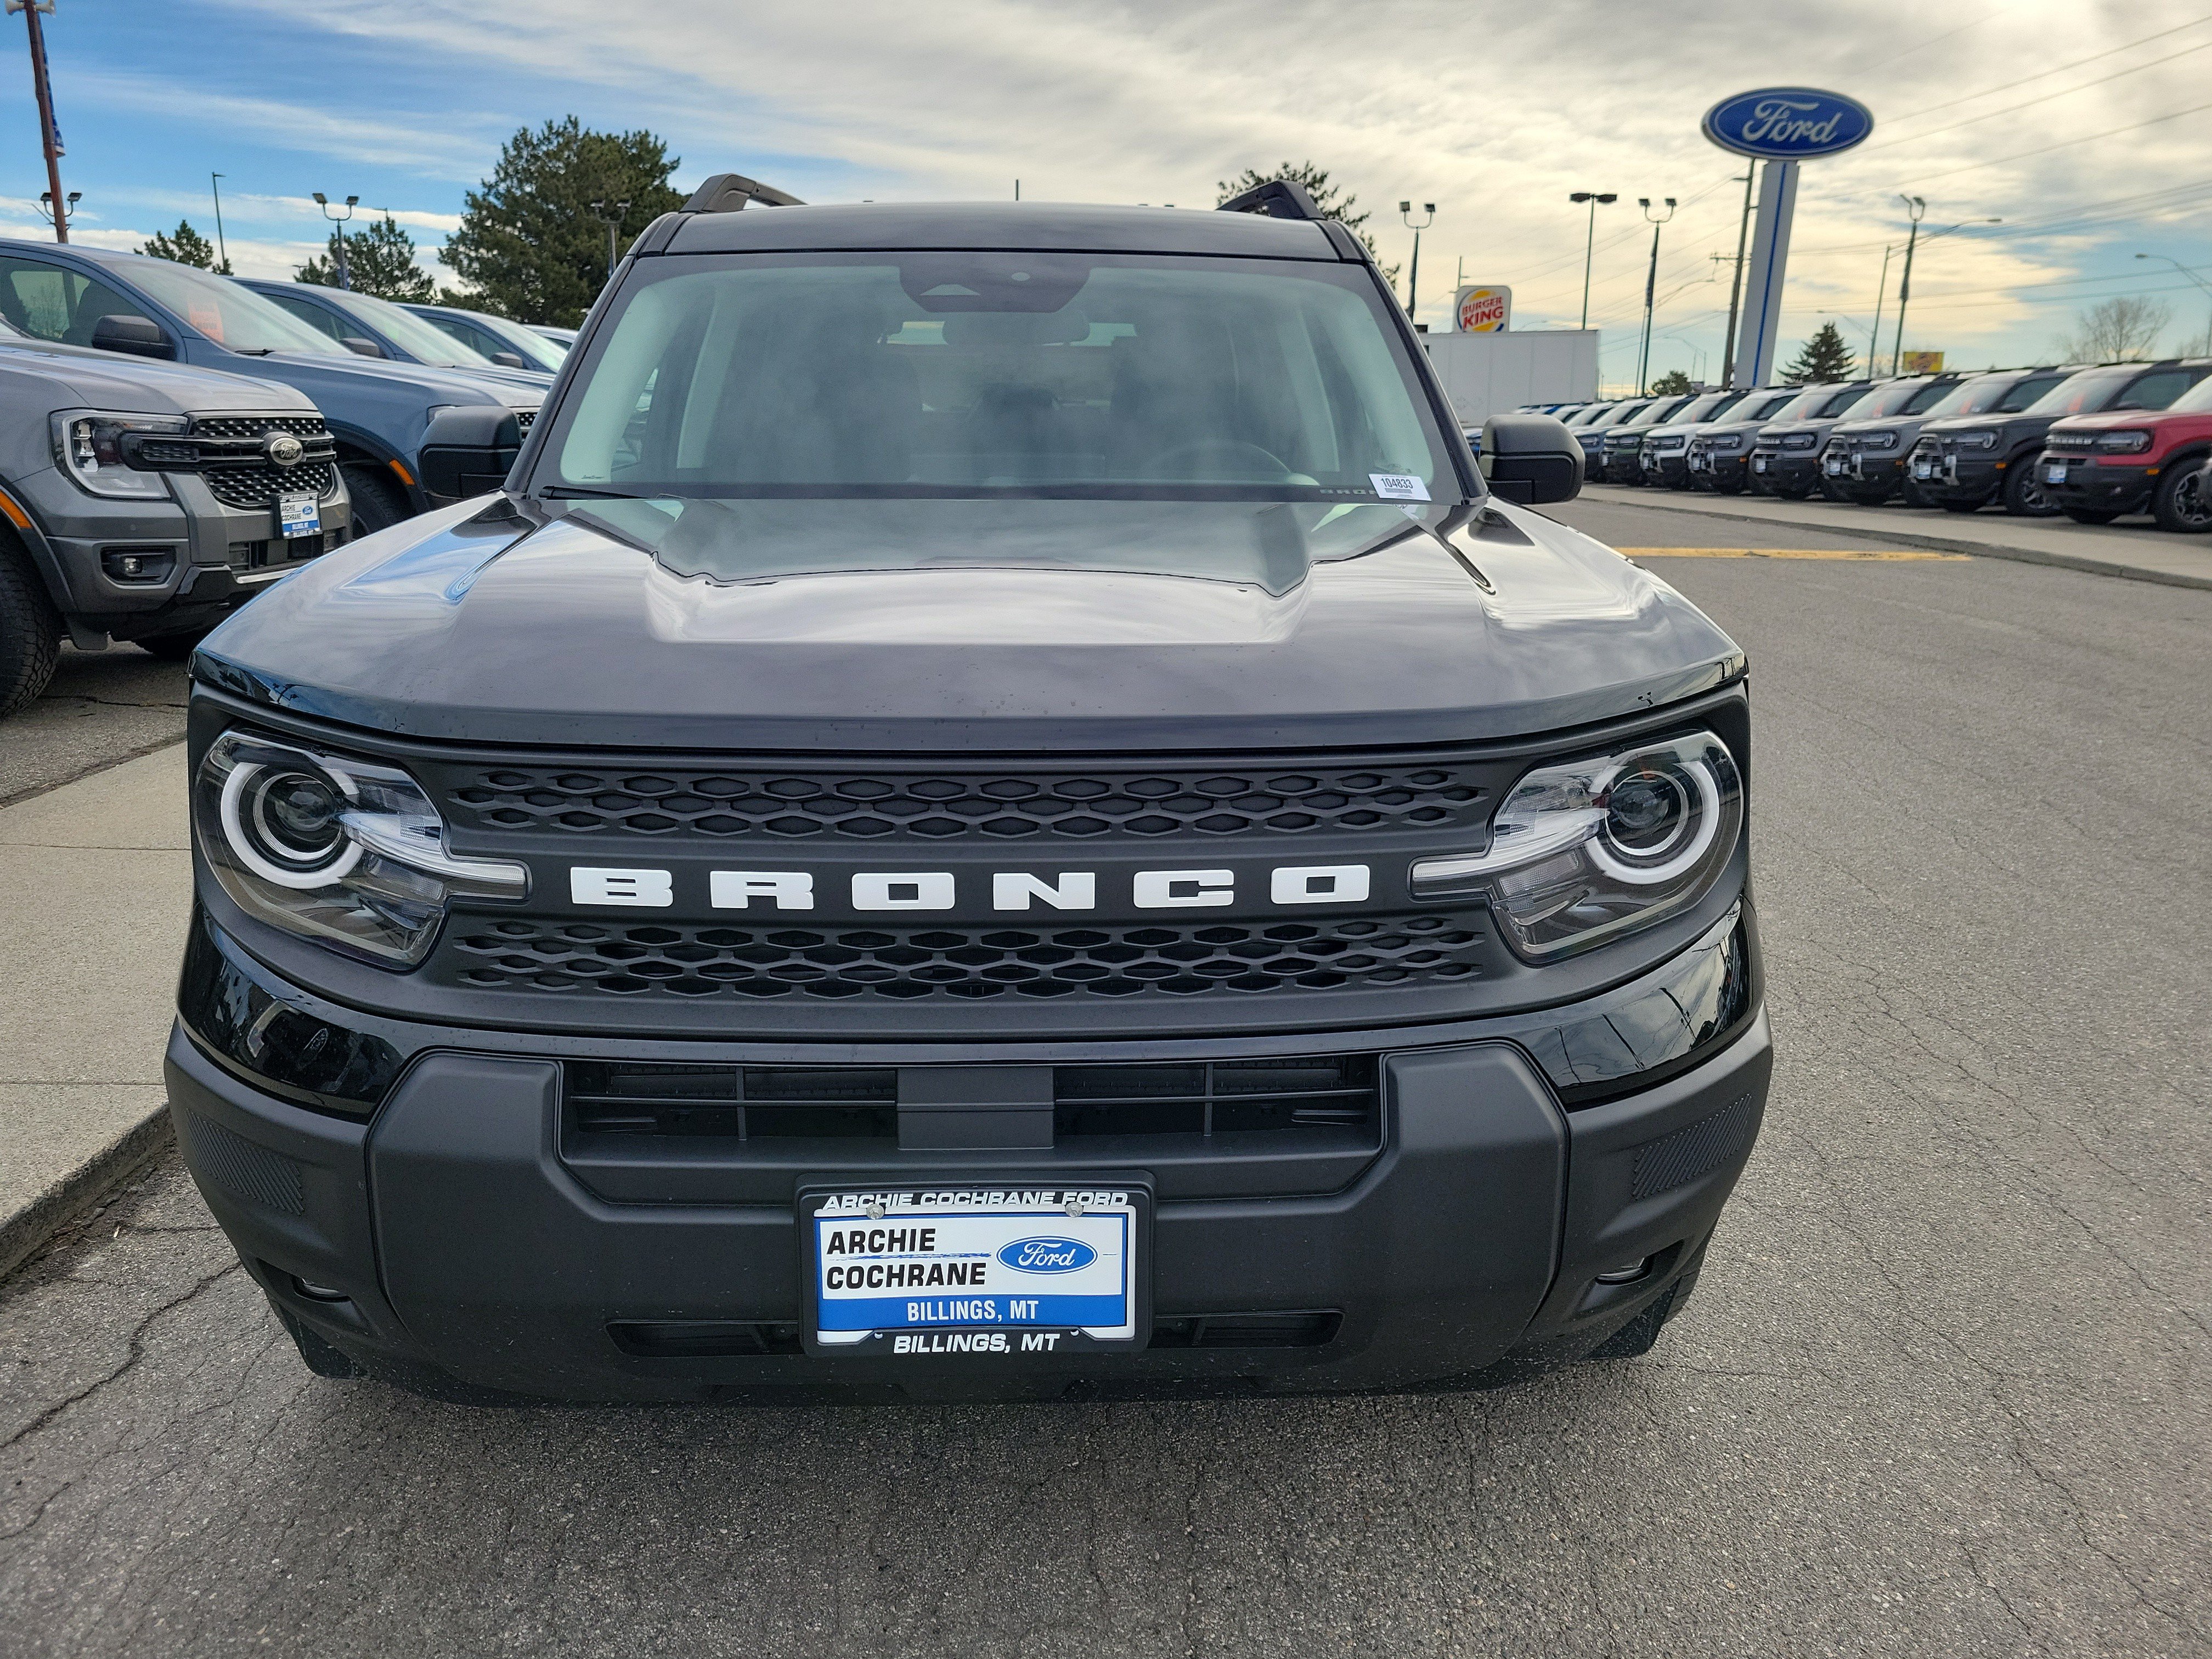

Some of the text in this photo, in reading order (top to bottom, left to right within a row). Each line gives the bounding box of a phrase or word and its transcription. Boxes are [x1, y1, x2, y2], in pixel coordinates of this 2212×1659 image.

[1742, 99, 1843, 143] Ford
[1463, 306, 1503, 330] KING
[1381, 478, 1413, 489] 104833
[571, 865, 1370, 910] BRONCO
[823, 1192, 1128, 1210] ARCHIE COCHRANE FORD
[826, 1228, 936, 1255] ARCHIE
[1018, 1242, 1076, 1266] Ford
[827, 1262, 986, 1290] COCHRANE
[907, 1300, 1039, 1322] BILLINGS, MT
[893, 1333, 1060, 1354] BILLINGS, MT
